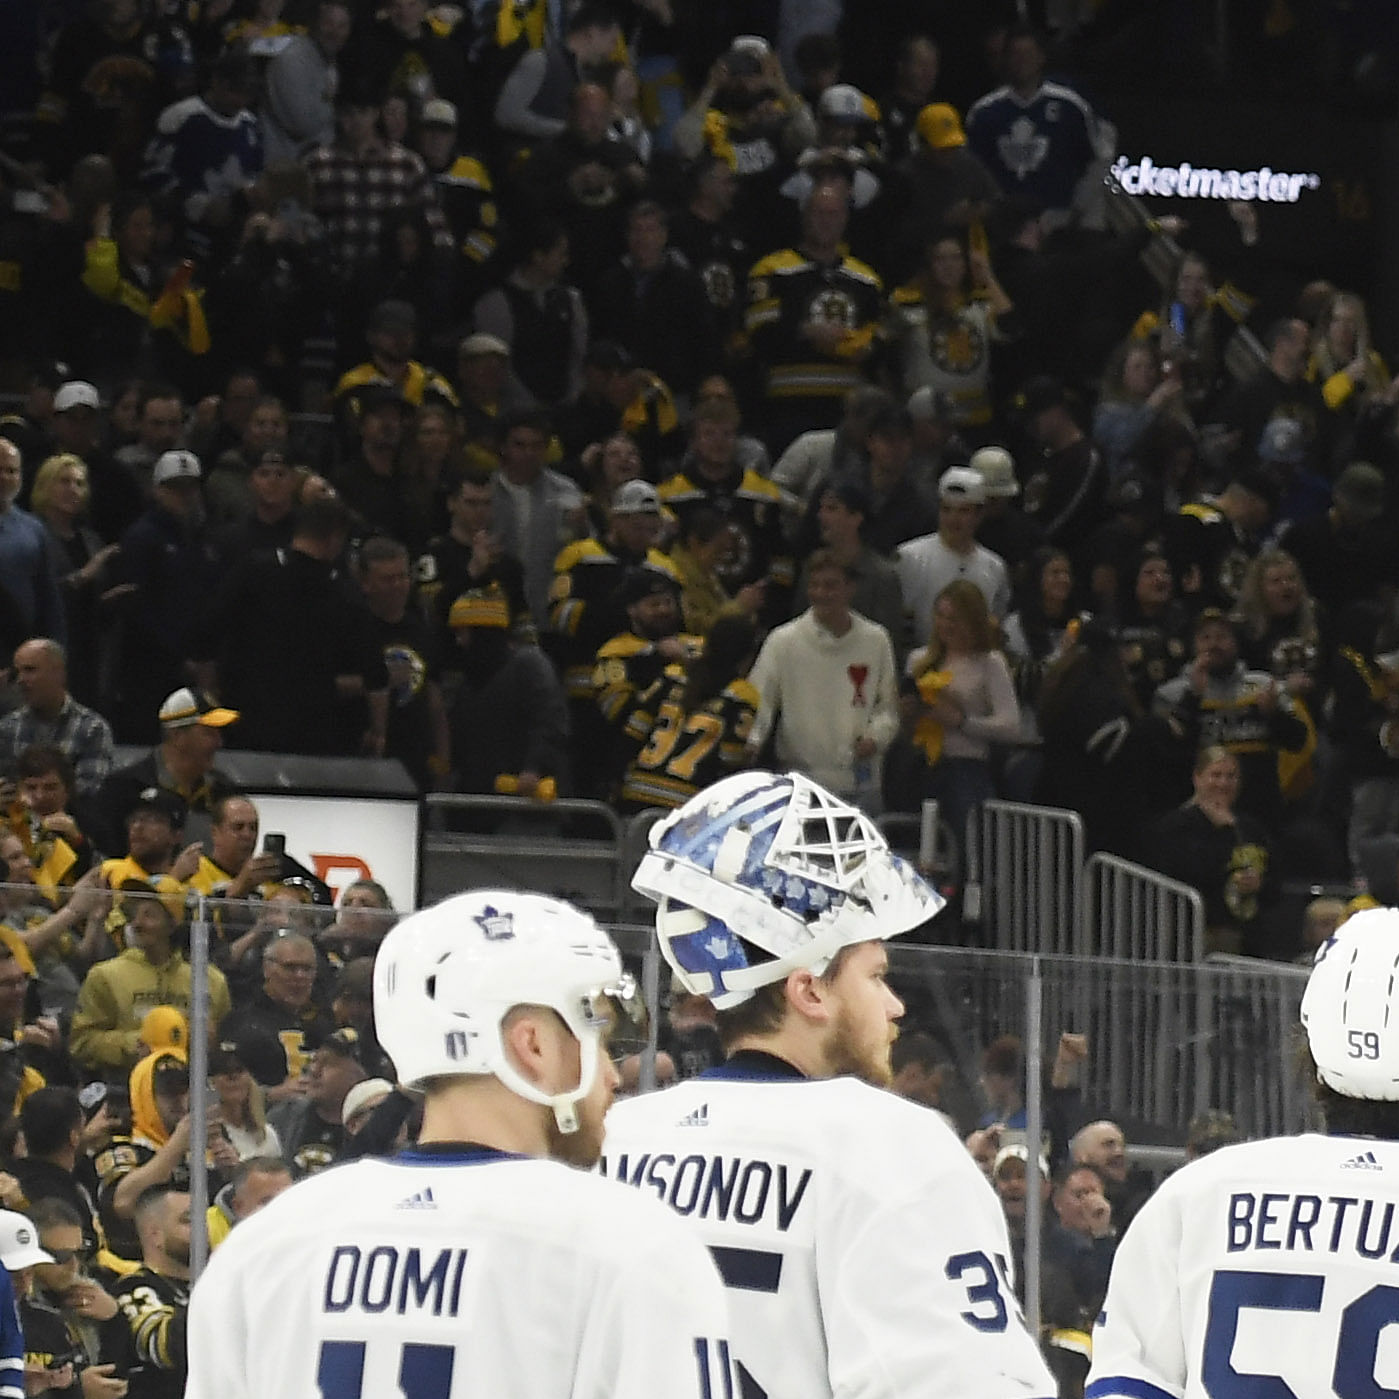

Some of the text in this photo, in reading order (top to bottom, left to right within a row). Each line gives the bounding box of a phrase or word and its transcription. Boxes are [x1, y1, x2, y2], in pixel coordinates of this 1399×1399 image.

[1107, 154, 1321, 204] icketmaster
[637, 703, 726, 771] 37
[1348, 1029, 1380, 1060] 59
[323, 1245, 468, 1318] DOMI
[944, 1250, 1026, 1335] 3
